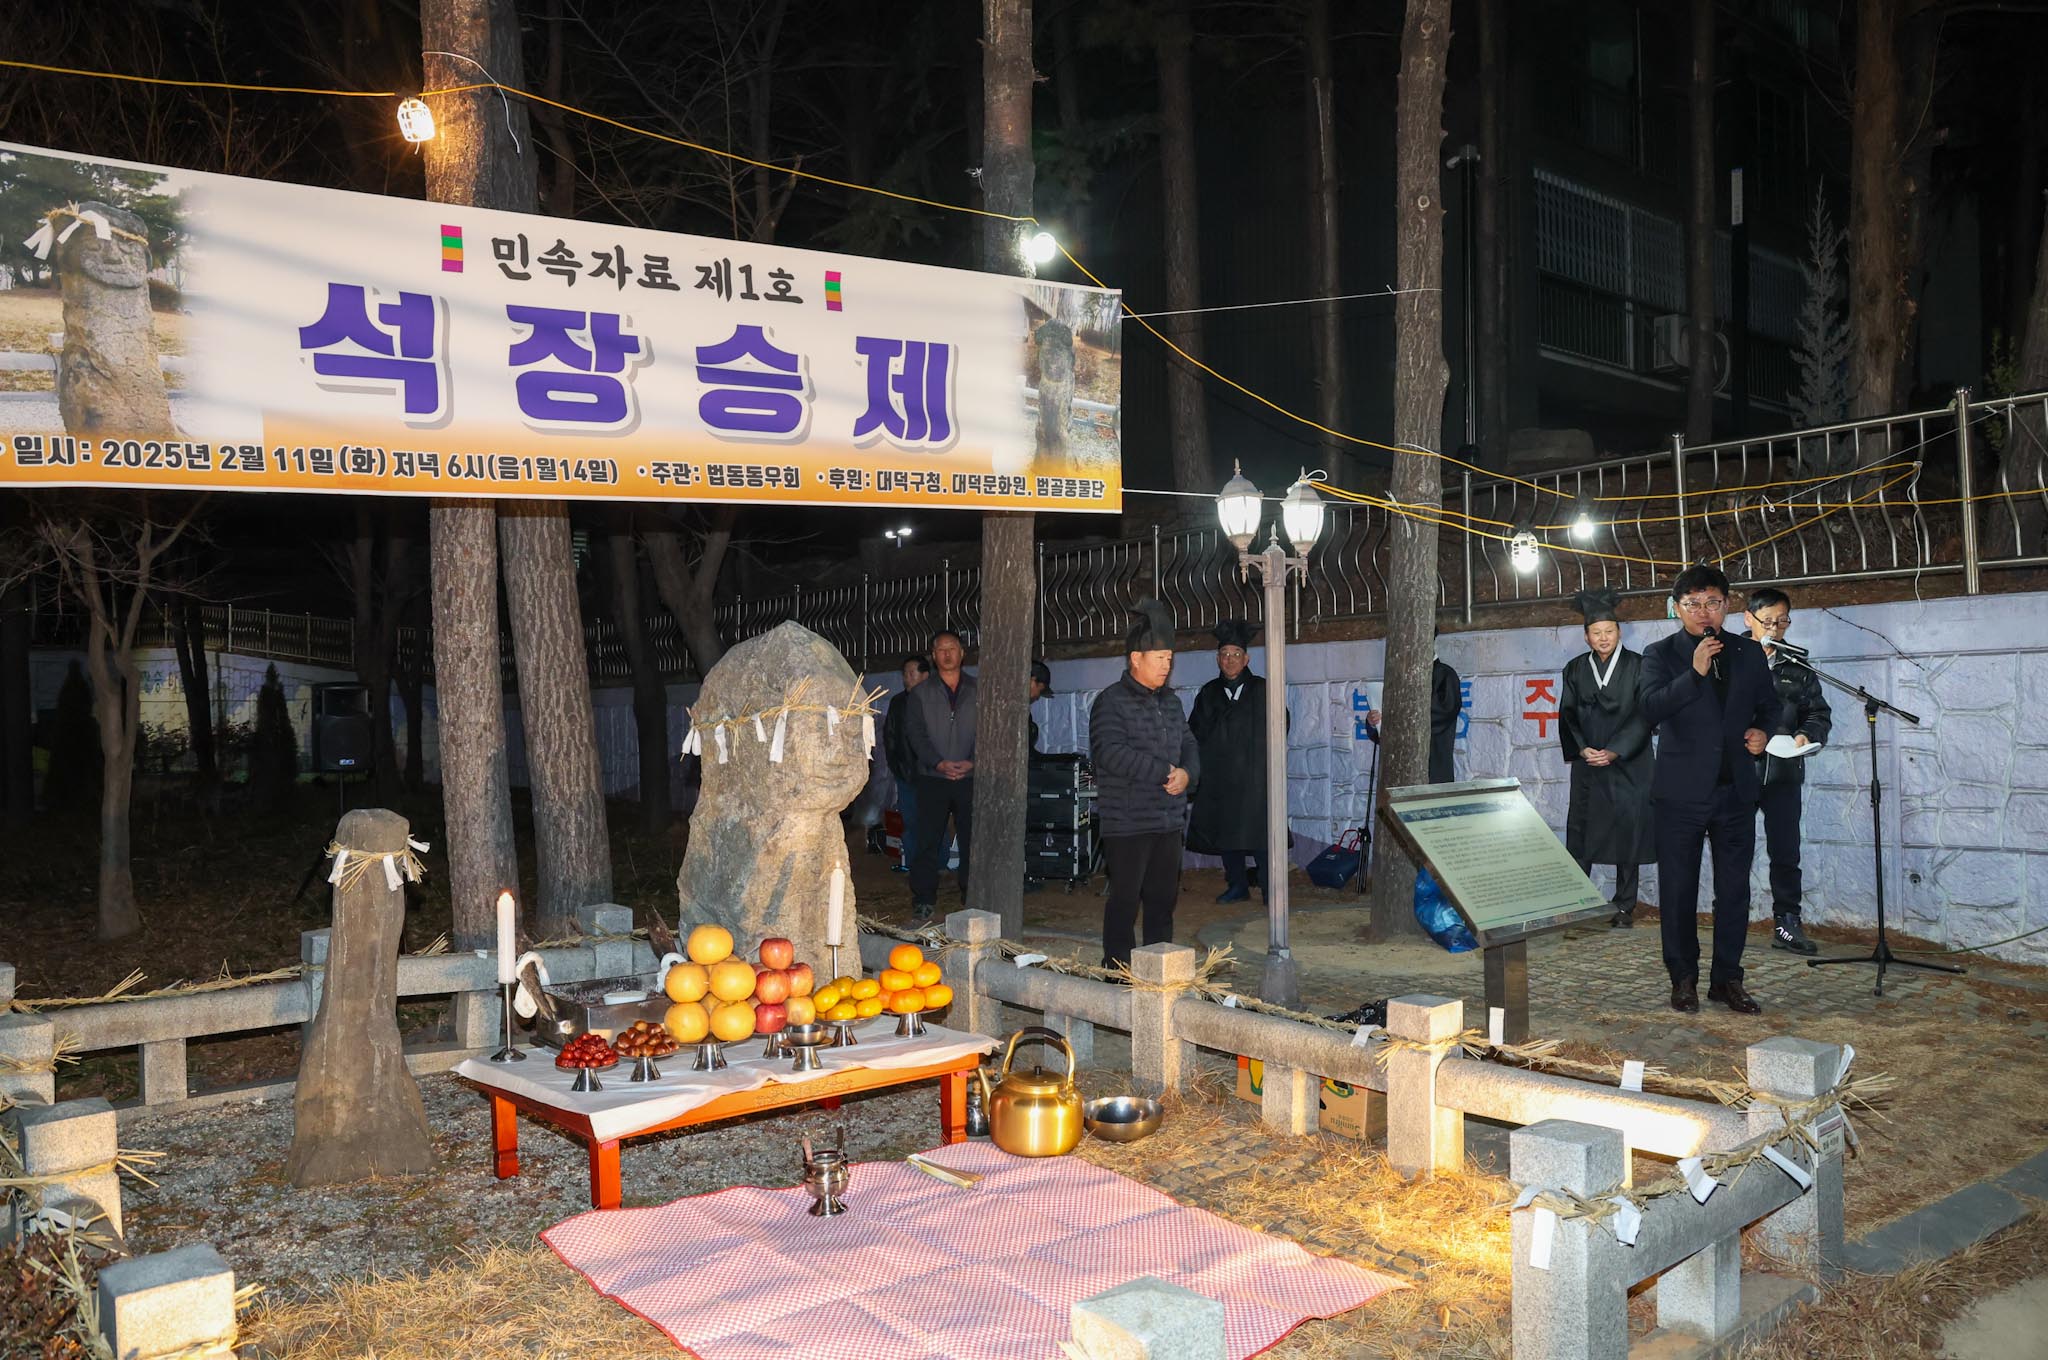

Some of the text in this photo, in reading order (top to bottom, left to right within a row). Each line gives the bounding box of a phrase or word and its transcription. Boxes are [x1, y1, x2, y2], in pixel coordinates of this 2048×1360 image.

[492, 233, 804, 304] 민속자료 제1호
[14, 436, 90, 465] 일시:
[102, 440, 211, 470] 2025년
[219, 445, 265, 471] 2월
[392, 452, 439, 478] 저녁
[447, 454, 618, 484] 6시(음1월14일)
[652, 462, 700, 485] 주관:
[707, 464, 800, 488] 법동동우회
[829, 468, 871, 490] 후원:
[1036, 477, 1105, 498] 범골풍물단
